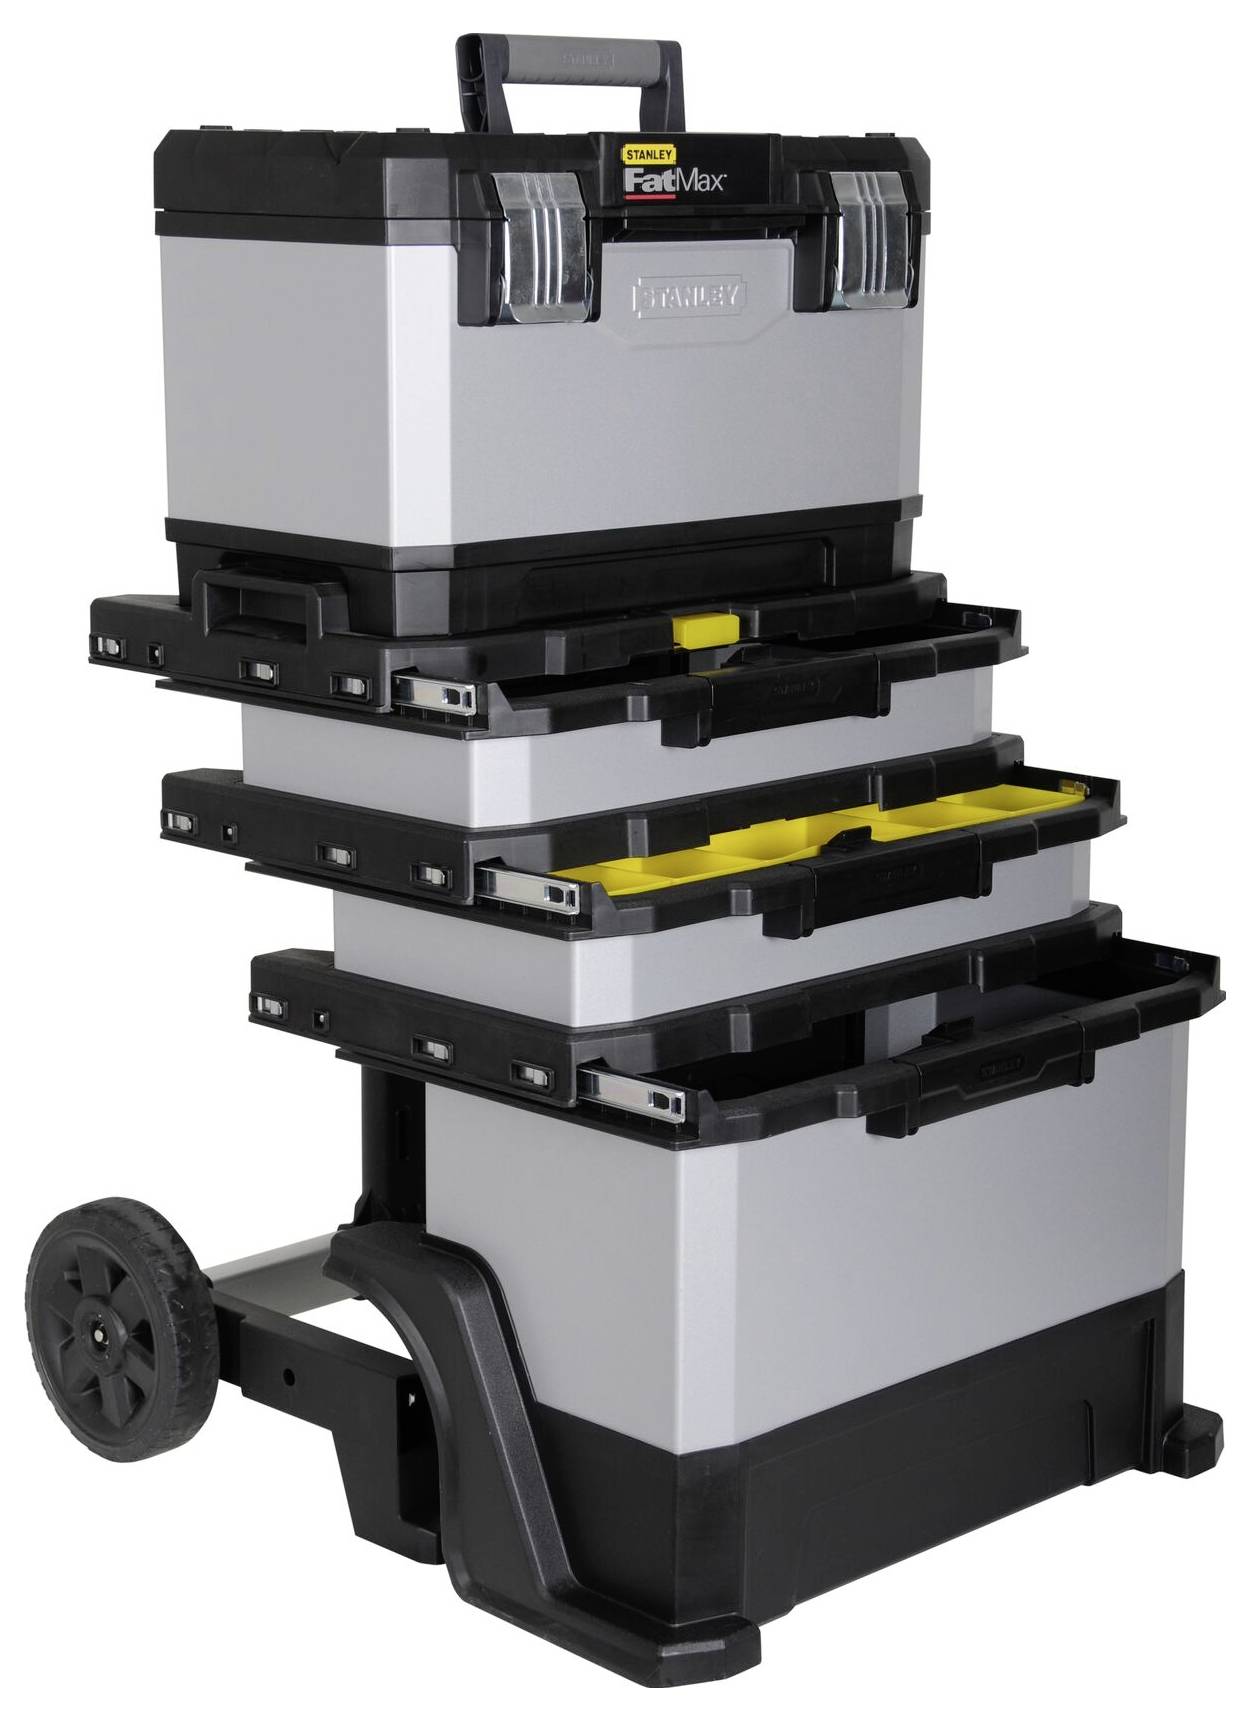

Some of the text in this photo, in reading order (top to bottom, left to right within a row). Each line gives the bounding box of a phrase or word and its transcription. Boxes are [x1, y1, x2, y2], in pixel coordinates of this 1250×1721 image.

[627, 149, 672, 161] STANLEY
[624, 167, 724, 192] FatMax
[642, 285, 738, 308] STANLEY
